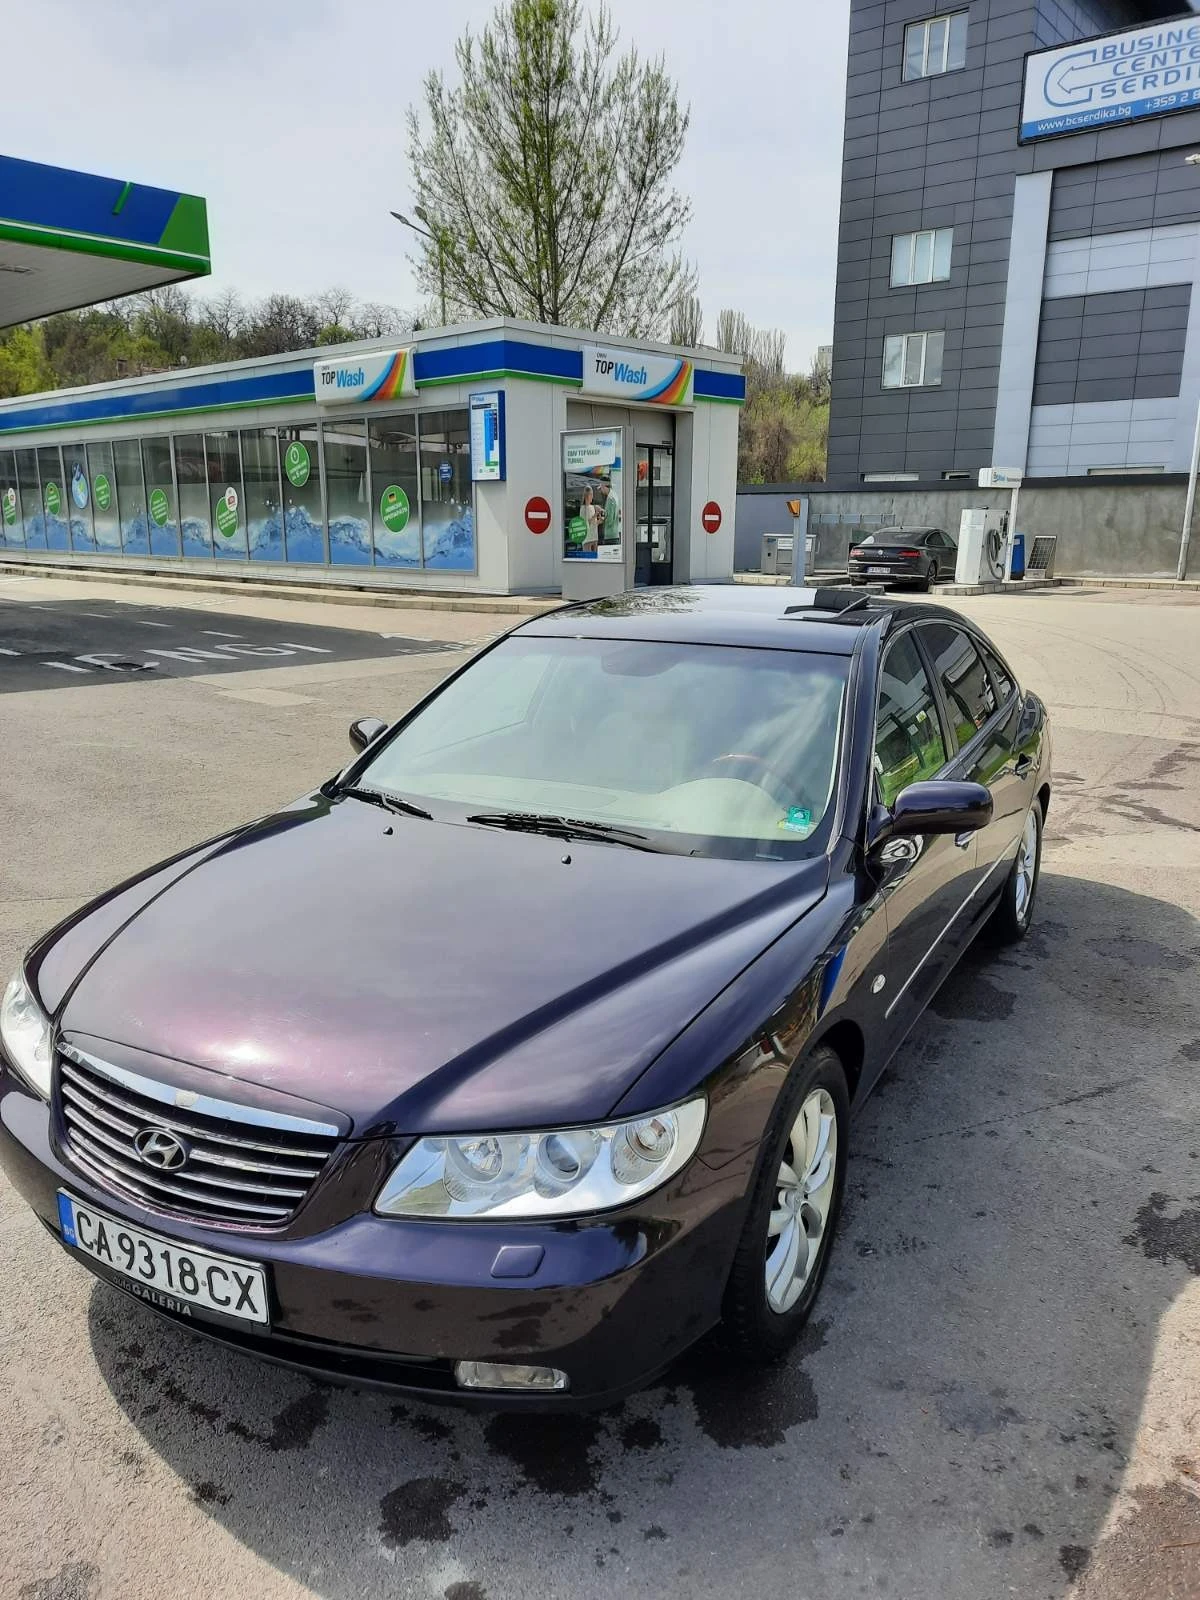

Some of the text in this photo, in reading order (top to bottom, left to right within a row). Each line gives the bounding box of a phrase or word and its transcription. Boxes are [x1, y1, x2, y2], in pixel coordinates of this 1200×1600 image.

[1101, 65, 1200, 100] SERDI
[1145, 95, 1177, 111] +359
[1180, 91, 1189, 103] 2
[1037, 105, 1131, 132] www.bcserdika.bg
